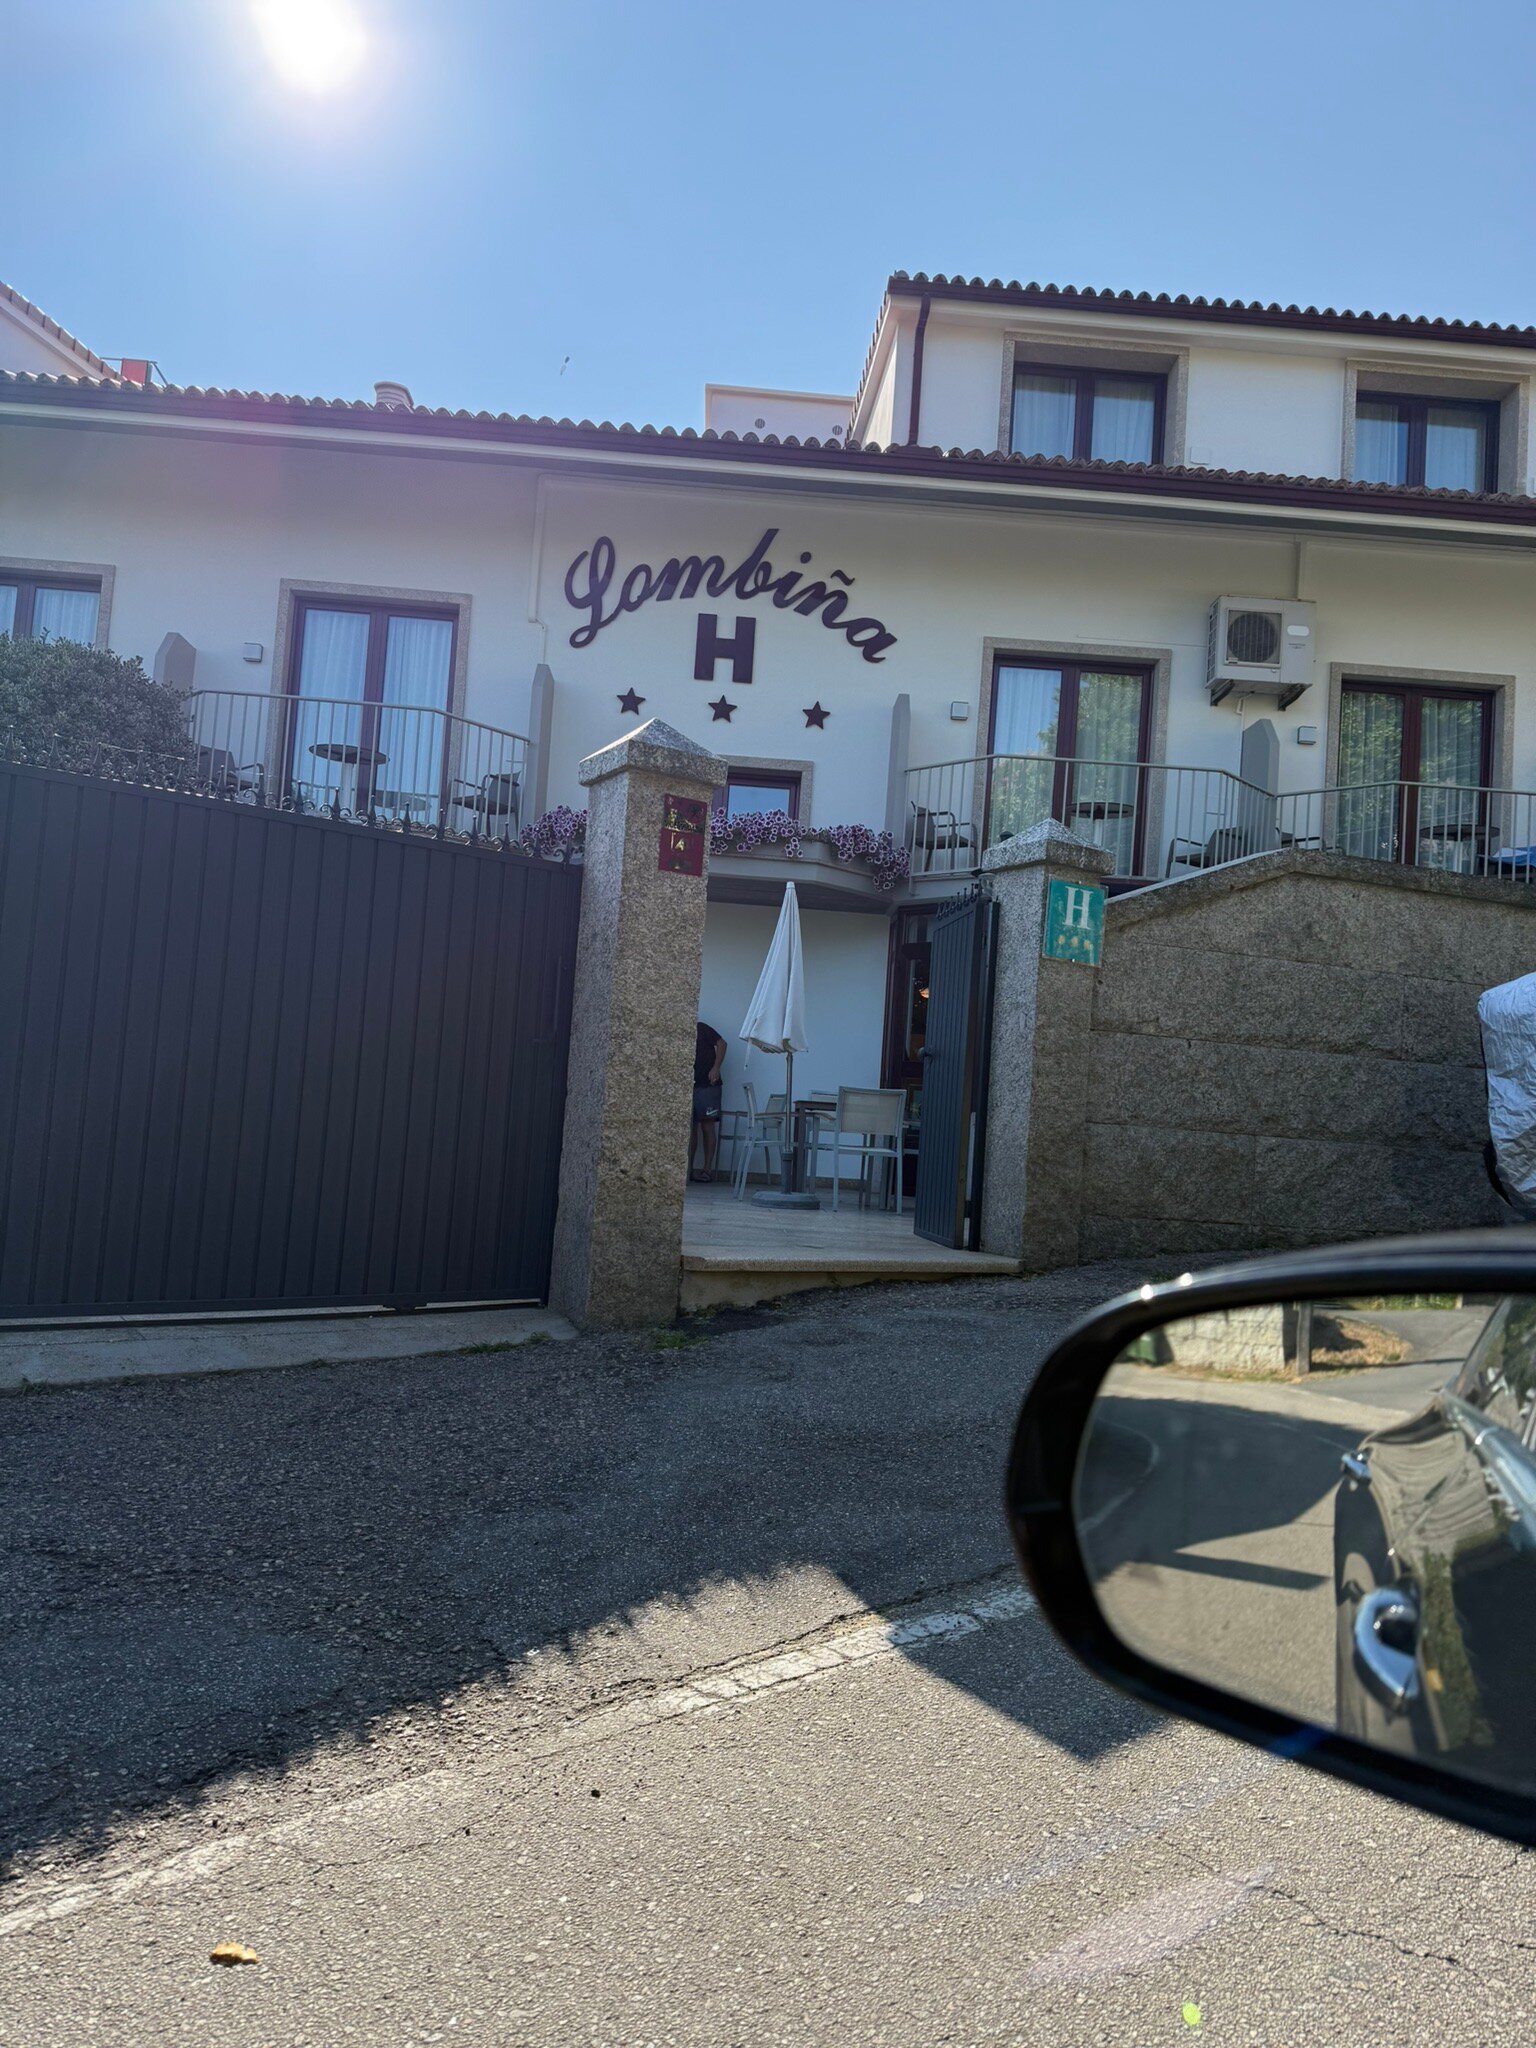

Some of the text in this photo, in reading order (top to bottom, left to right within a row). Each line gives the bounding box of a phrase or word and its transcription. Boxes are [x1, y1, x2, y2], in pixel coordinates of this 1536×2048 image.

[564, 528, 898, 663] Lombiña
[694, 613, 757, 684] H
[1062, 886, 1094, 930] H
